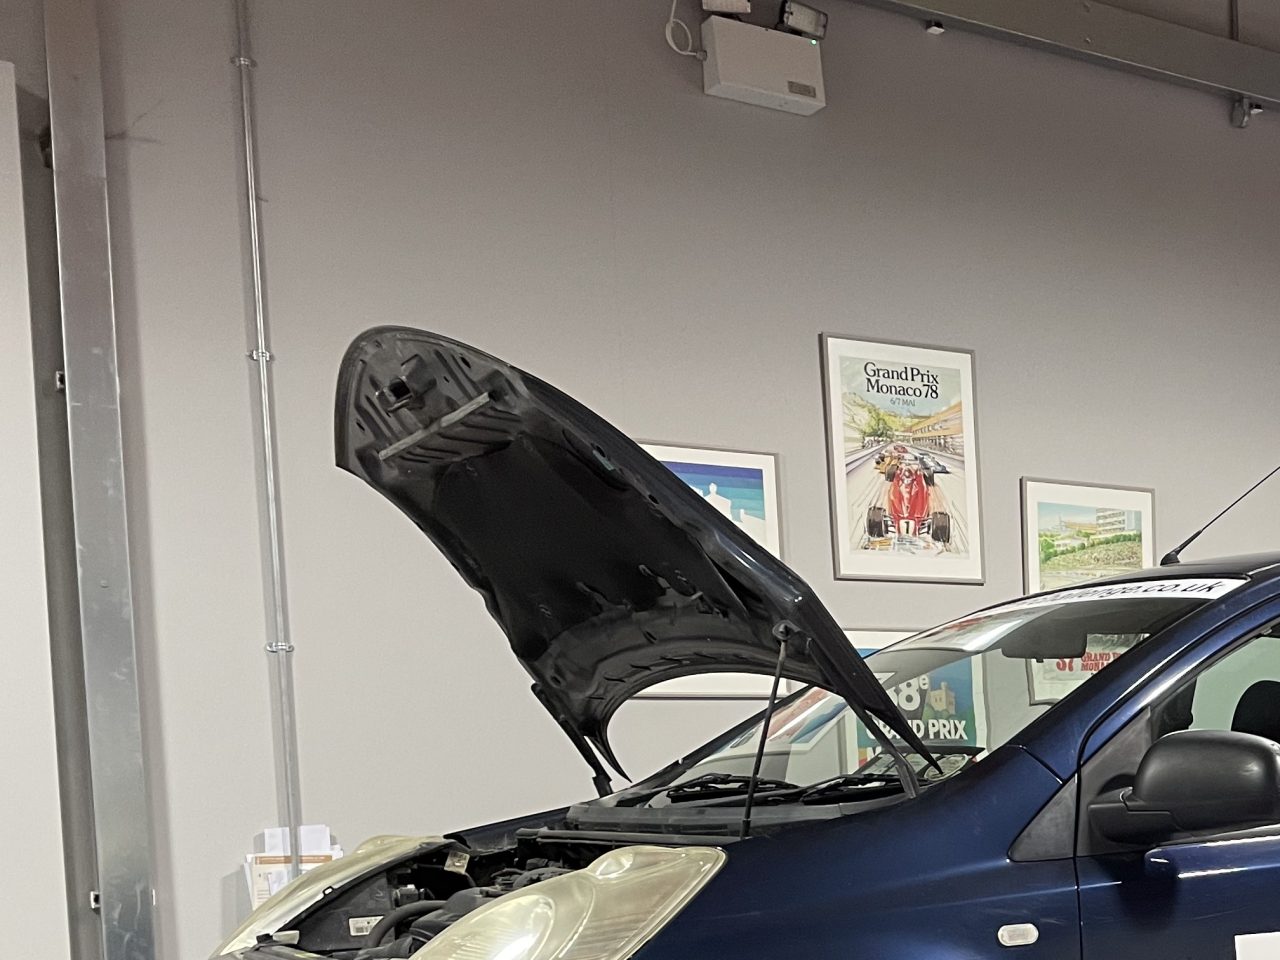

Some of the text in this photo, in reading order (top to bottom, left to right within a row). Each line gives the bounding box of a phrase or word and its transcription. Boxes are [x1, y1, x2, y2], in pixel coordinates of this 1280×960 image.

[864, 361, 939, 385] Grand Prix
[866, 378, 939, 399] Monaco 78
[928, 719, 968, 740] PRIX
